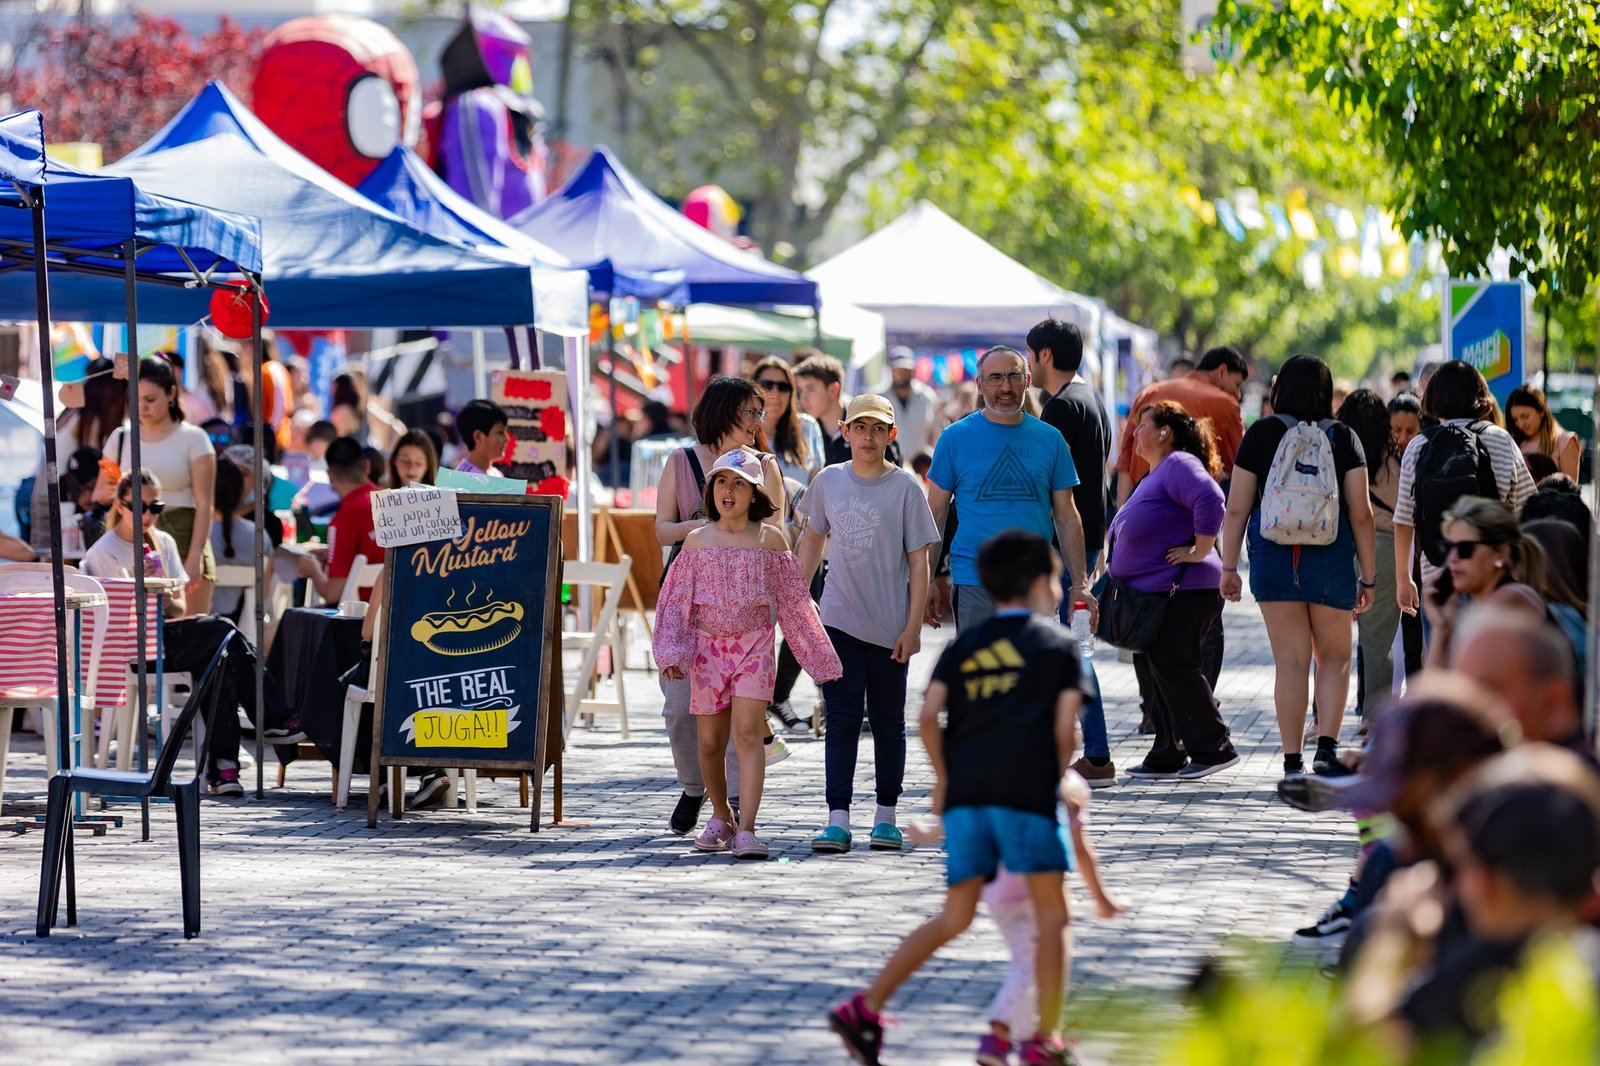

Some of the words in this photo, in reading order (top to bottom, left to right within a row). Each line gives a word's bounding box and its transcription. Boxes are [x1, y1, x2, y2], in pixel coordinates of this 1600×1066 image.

[378, 512, 396, 528] de
[403, 508, 431, 527] papa
[451, 516, 532, 552] Yellow
[380, 527, 407, 546] gana
[411, 525, 425, 537] un
[411, 540, 517, 578] Mustard
[410, 678, 452, 708] THE
[460, 669, 515, 701] REAL
[423, 711, 498, 741] JUGA!!
